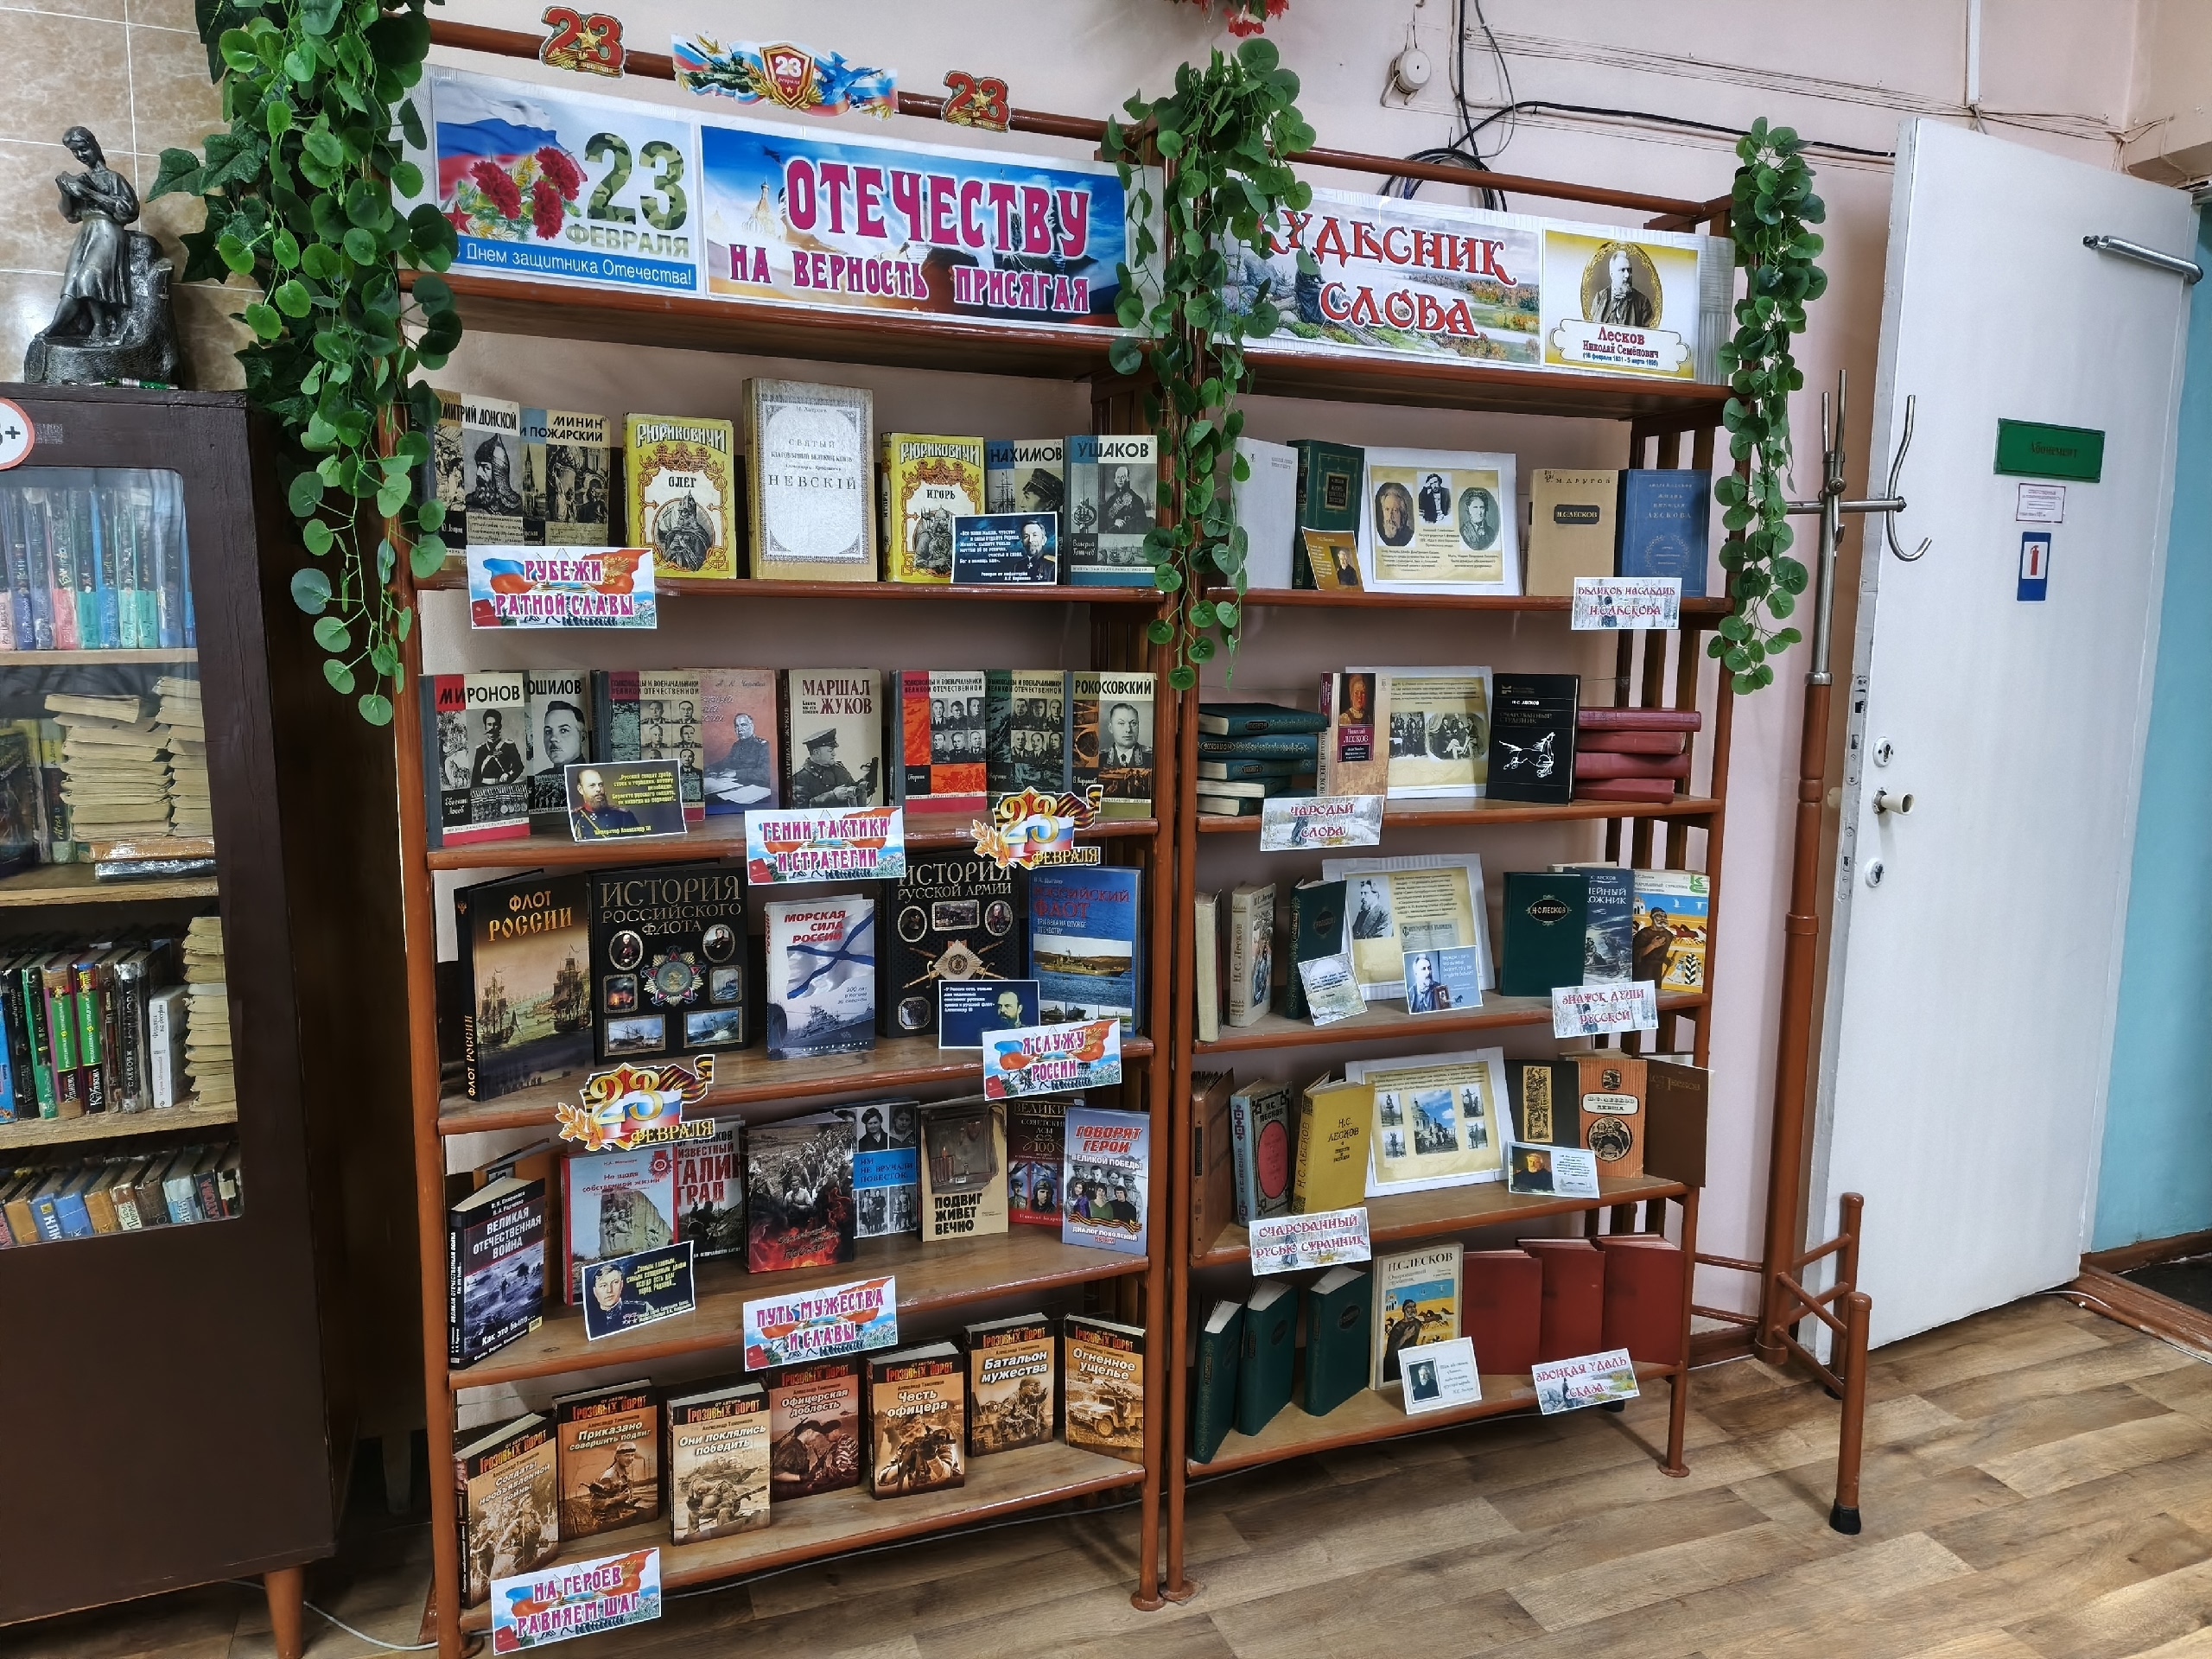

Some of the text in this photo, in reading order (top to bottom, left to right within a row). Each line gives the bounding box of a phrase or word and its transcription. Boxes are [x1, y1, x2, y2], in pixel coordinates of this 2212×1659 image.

[545, 7, 622, 67] 23
[775, 56, 802, 78] 23
[945, 71, 1008, 124] 23
[584, 132, 688, 231] 23
[786, 160, 1089, 257] ОТЕЧЕСТВУ
[565, 224, 690, 257] ФЕВРАЛЯ
[466, 243, 507, 264] Днем
[512, 251, 598, 276] защитника
[602, 259, 691, 285] Отечества!
[729, 244, 1090, 312] НА ВЕРНОСТЬ ПРИСЯГАЯ
[1320, 281, 1478, 337] СЛОВА
[1598, 327, 1645, 345] Лесков
[1583, 340, 1659, 359] Николай Семёнович
[479, 408, 517, 430] ДОНСКОЙ
[553, 415, 603, 430] МИНИН
[520, 426, 603, 442] И ПОЖАРСКИЙ
[636, 423, 727, 454] РЮРИКОВИЧИ
[789, 439, 835, 448] СВЯТЫЙ
[899, 442, 981, 467] РЮРИКОВИЧИ
[990, 446, 1063, 463] НАХИМОВ
[1077, 442, 1149, 458] УШАКОВ
[668, 476, 696, 488] ОЛЕГ
[926, 489, 956, 499] ИГОРЬ
[524, 560, 602, 582] РУБЕЖИ
[495, 593, 633, 616] РАТНОЙ СЛАВЫ
[439, 685, 521, 705] МИРОНОВ
[803, 680, 870, 696] МАРШАЛ
[932, 683, 982, 692] ОТЕЧЕСТВЕННОЙ
[1014, 685, 1062, 695] ОТЕЧЕСТВЕННОЙ
[1075, 678, 1152, 695] РОКОССОВСКИЙ
[820, 698, 872, 714] ЖУКОВ
[999, 796, 1059, 843] 23
[762, 818, 889, 842] ГЕНИИ ТАКТИКИ
[1301, 825, 1344, 838] СЛОВА
[778, 849, 877, 873] И СТРАТЕГИИ
[1032, 849, 1099, 865] ФЕВРАЛЯ
[899, 862, 1012, 887] ИСТОРИЯ
[509, 891, 551, 912] ФЛОТ
[601, 876, 741, 908] ИСТОРИЯ
[898, 882, 1012, 903] РУССКОЙ АРМИИ
[1033, 886, 1129, 903] РОССИЙСКИЙ
[601, 902, 741, 924] РОССИЙСКОГО
[785, 911, 846, 923] МОРСКАЯ
[1033, 899, 1090, 919] ФЛОТ
[489, 907, 572, 942] РОССИИ
[641, 920, 703, 936] ФЛОТА
[810, 921, 843, 931] СИЛА
[792, 931, 842, 944] РОССИИ
[1234, 924, 1243, 958] Лесков
[1611, 988, 1644, 1002] ДУШИ
[1580, 1010, 1630, 1025] РУССКОЙ
[465, 1014, 474, 1062] РОССИИ
[1023, 1030, 1085, 1055] Я СЛУЖУ
[467, 1066, 476, 1096] ФЛОТ
[1032, 1061, 1077, 1081] РОССИИ
[590, 1073, 664, 1124] 23
[631, 1120, 713, 1145] ФЕВРАЛЯ
[1338, 1117, 1351, 1128] Н.С.
[1076, 1126, 1142, 1140] ГОВОРЯТ
[1328, 1127, 1359, 1142] ЛЕСКОВ
[1034, 1142, 1054, 1152] 100
[1083, 1140, 1132, 1154] ГЕРОИ
[1300, 1122, 1310, 1166] ЛЕСКОВ
[875, 1163, 913, 1173] ВРУЧАЛИ
[1071, 1154, 1142, 1170] ВЕЛИКОЙ ПОБЕДЫ
[582, 1178, 660, 1192] собственной жизни
[934, 1192, 982, 1209] ПОДВИГ
[487, 1207, 529, 1235] ВЕЛИКАЯ
[935, 1207, 977, 1222] ЖИВЕТ
[474, 1215, 541, 1255] ОТЕЧЕСТВЕННАЯ
[935, 1220, 975, 1235] ВЕЧНО
[1099, 1230, 1137, 1241] ПОКОЛЕНИЙ
[1259, 1214, 1358, 1238] ОЧАРОВАННЫЙ
[493, 1236, 523, 1259] ВОЙНА
[1389, 1253, 1452, 1272] Н.С.ЛЕСКОВ
[756, 1287, 884, 1329] ПУТЬ МУЖЕСТВА
[482, 1315, 535, 1345] Как это было...
[790, 1321, 856, 1350] И СЛАВЫ
[984, 1351, 1047, 1370] Батальон
[1073, 1347, 1135, 1371] Огненное
[981, 1363, 1047, 1383] мужества
[1080, 1361, 1129, 1380] ущелье
[1535, 1355, 1628, 1385] ЗВОНКАЯ УДАЛЬ
[782, 1389, 849, 1408] Офицерская
[898, 1390, 938, 1403] Честь
[790, 1401, 841, 1418] доблесть
[887, 1401, 948, 1418] офицера
[569, 1429, 651, 1451] совершить подвиг
[579, 1422, 643, 1441] Приказано
[679, 1425, 766, 1446] Они поклялись
[696, 1440, 750, 1455] победить
[495, 1461, 537, 1486] Солдаты
[480, 1464, 550, 1505] необъявленной
[502, 1484, 532, 1503] войны
[534, 1566, 622, 1603] НА ГЕРОЕВ
[516, 1592, 640, 1637] РАВНЯЕМ ШАГ
